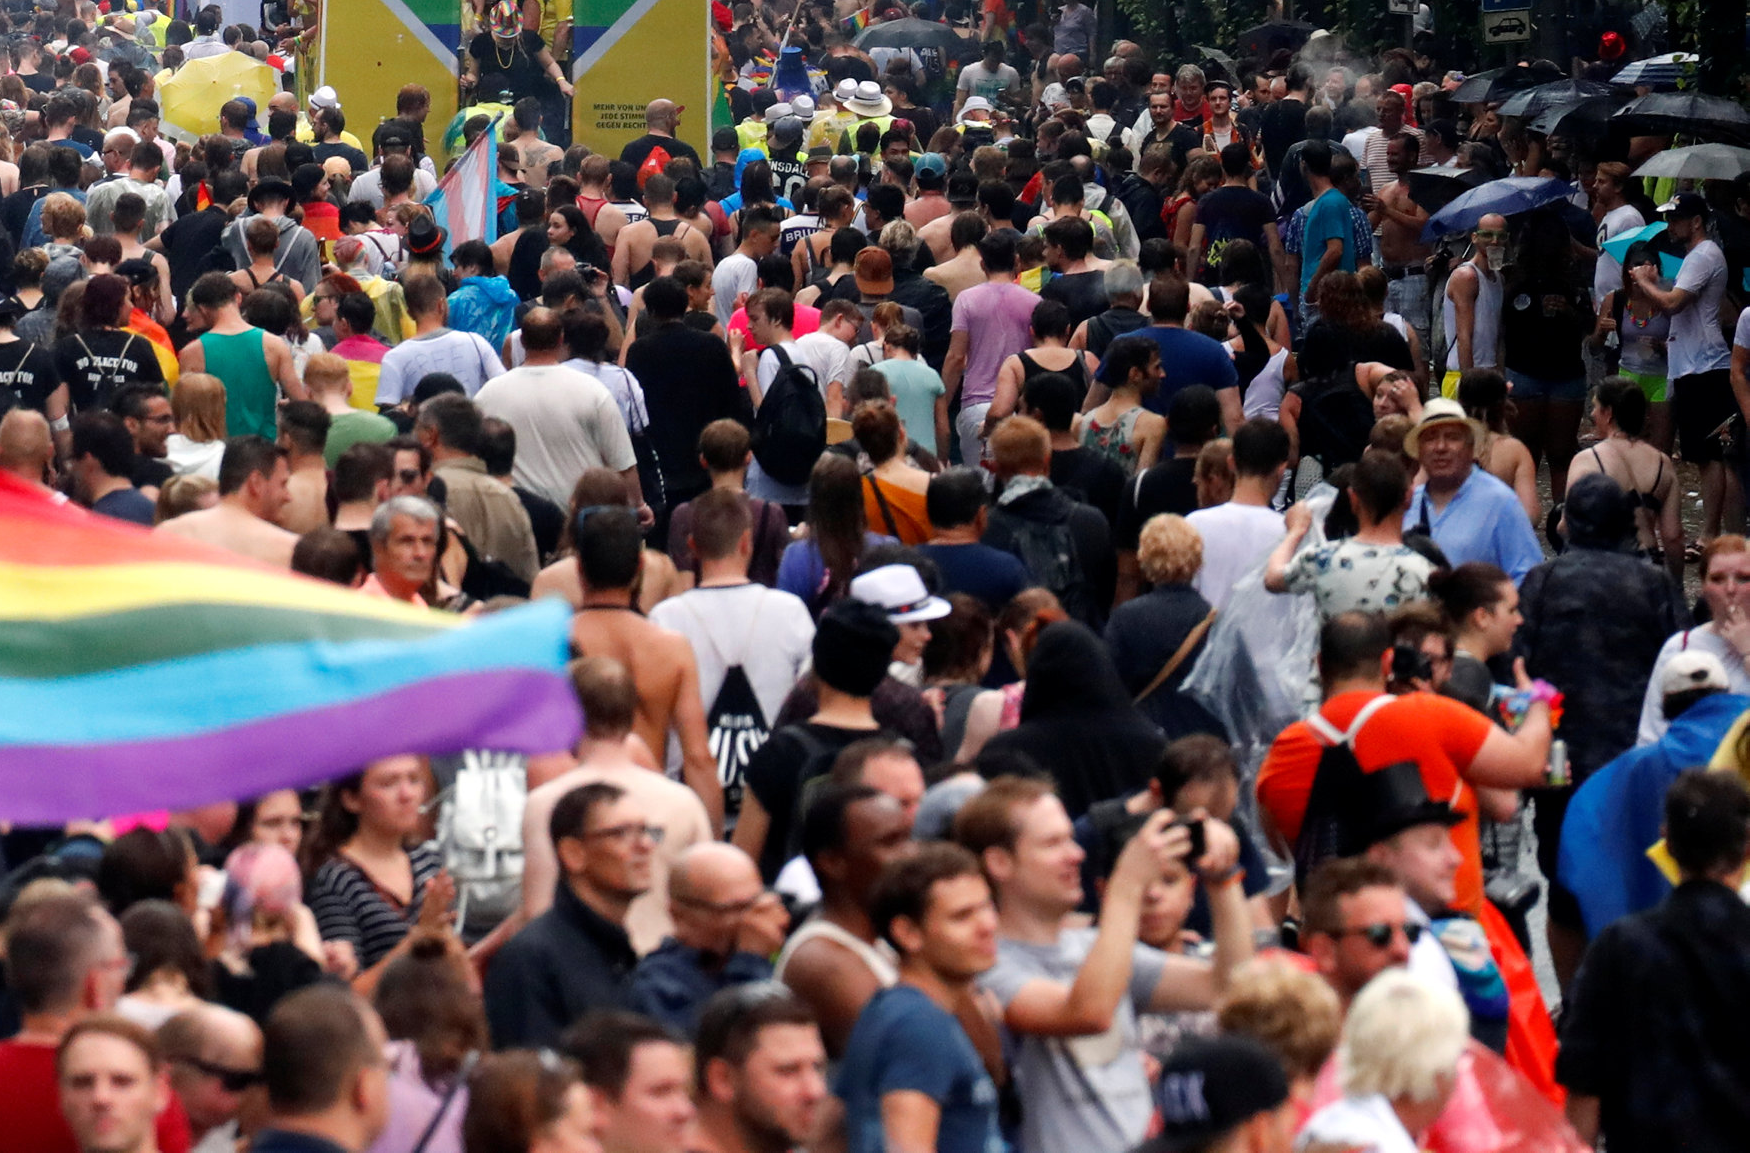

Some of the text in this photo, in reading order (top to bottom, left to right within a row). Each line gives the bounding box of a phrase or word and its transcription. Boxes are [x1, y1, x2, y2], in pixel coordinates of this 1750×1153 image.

[93, 355, 120, 368] PLACE
[121, 358, 138, 374] FOR
[16, 371, 34, 386] FOR
